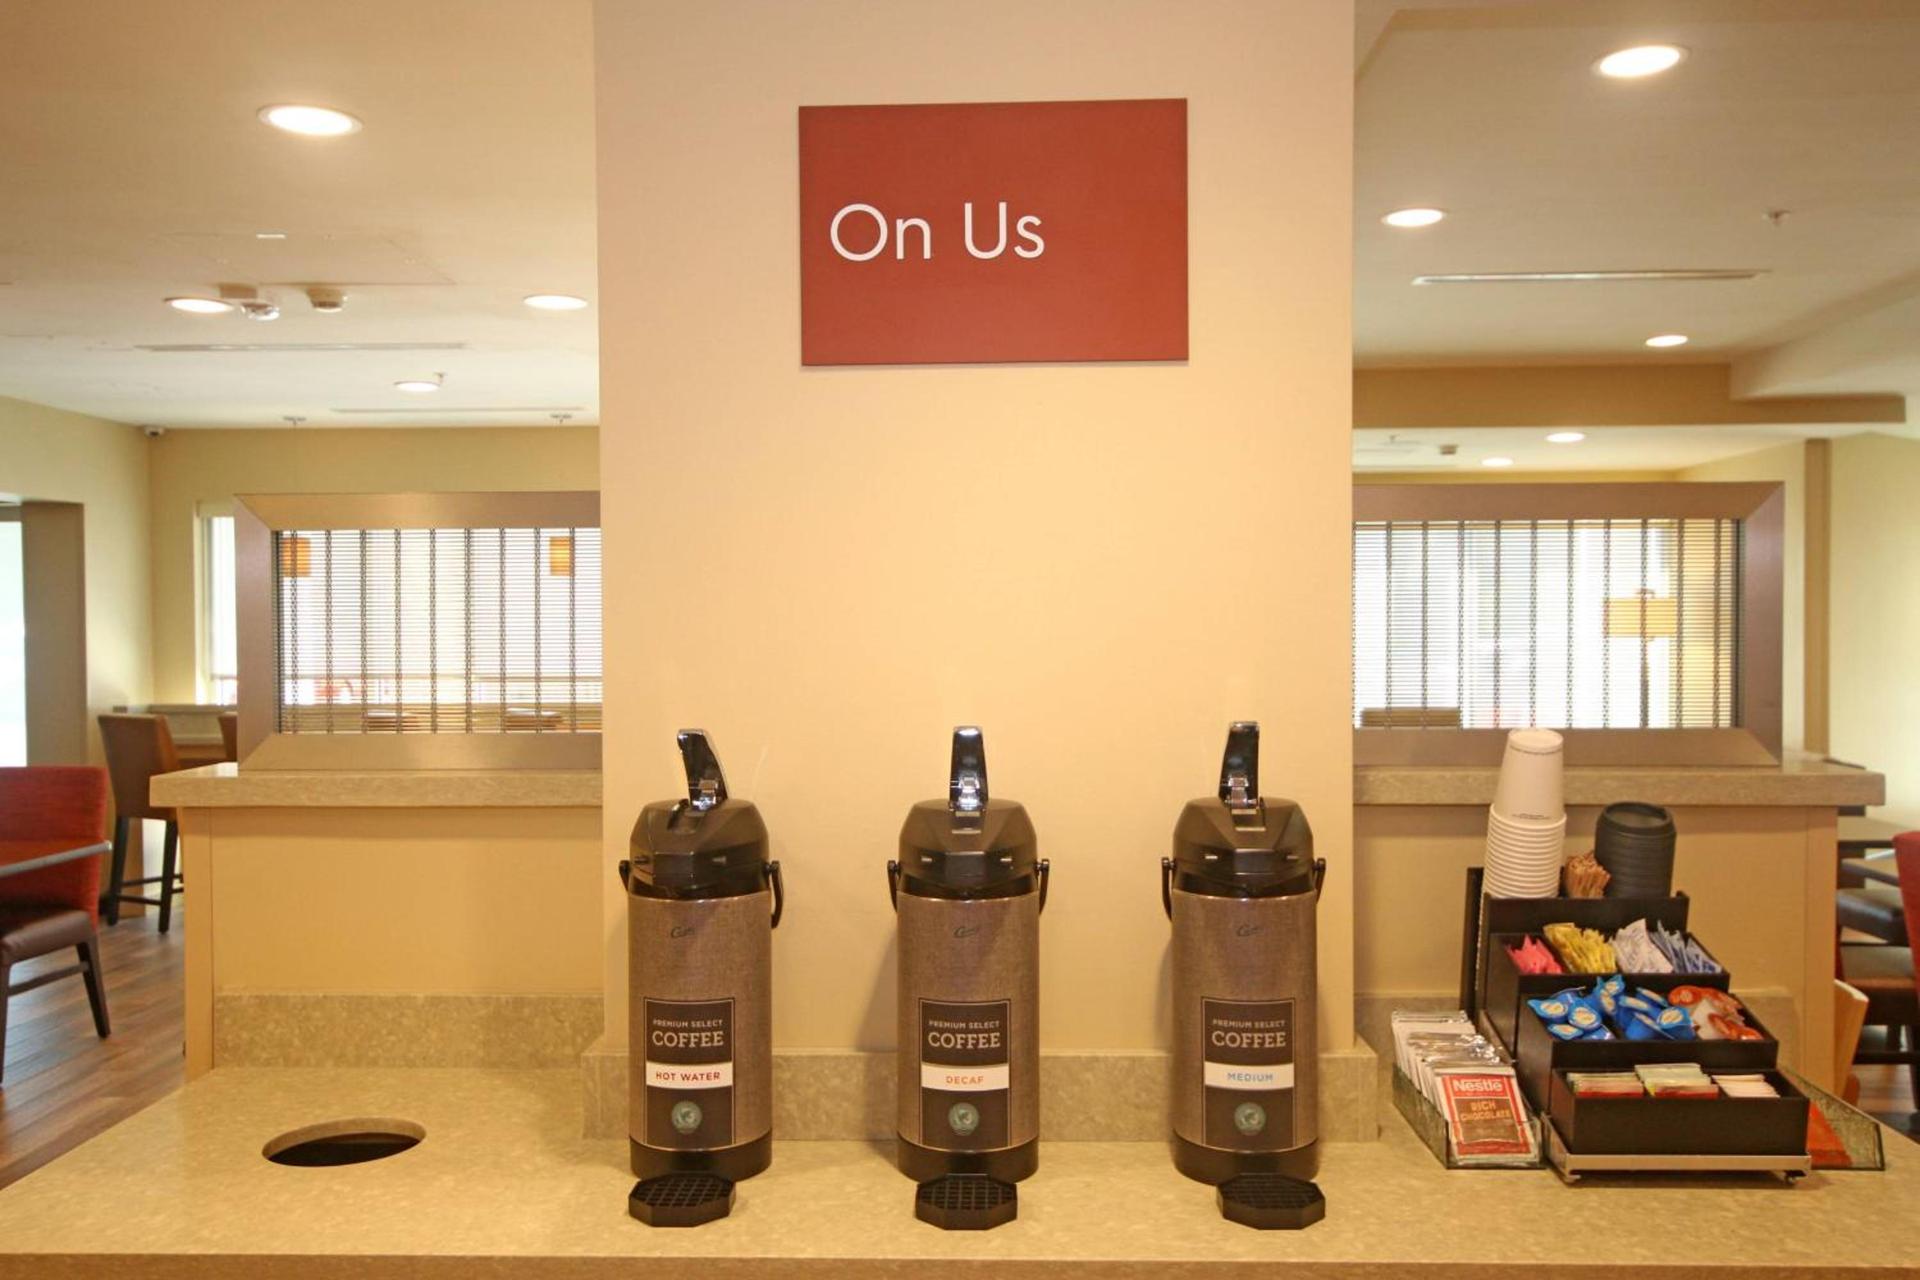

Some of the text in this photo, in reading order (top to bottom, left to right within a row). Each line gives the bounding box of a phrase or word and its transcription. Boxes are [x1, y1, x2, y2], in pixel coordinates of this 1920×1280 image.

[830, 201, 1045, 262] On Us
[652, 1018, 723, 1028] PREMIUM SELECT
[928, 1020, 1000, 1030] PREMIUM SELECT
[1212, 1018, 1286, 1029] PREMIUM SELECT
[652, 1030, 725, 1048] COFFEE
[927, 1031, 1001, 1049] COFFEE
[1211, 1030, 1287, 1048] COFFEE
[655, 1071, 721, 1081] HOT WATER
[945, 1075, 985, 1085] DECAF
[1226, 1071, 1274, 1083] MEDIUM
[1470, 1101, 1496, 1111] RICH
[1459, 1109, 1512, 1121] CHOCOLATE
